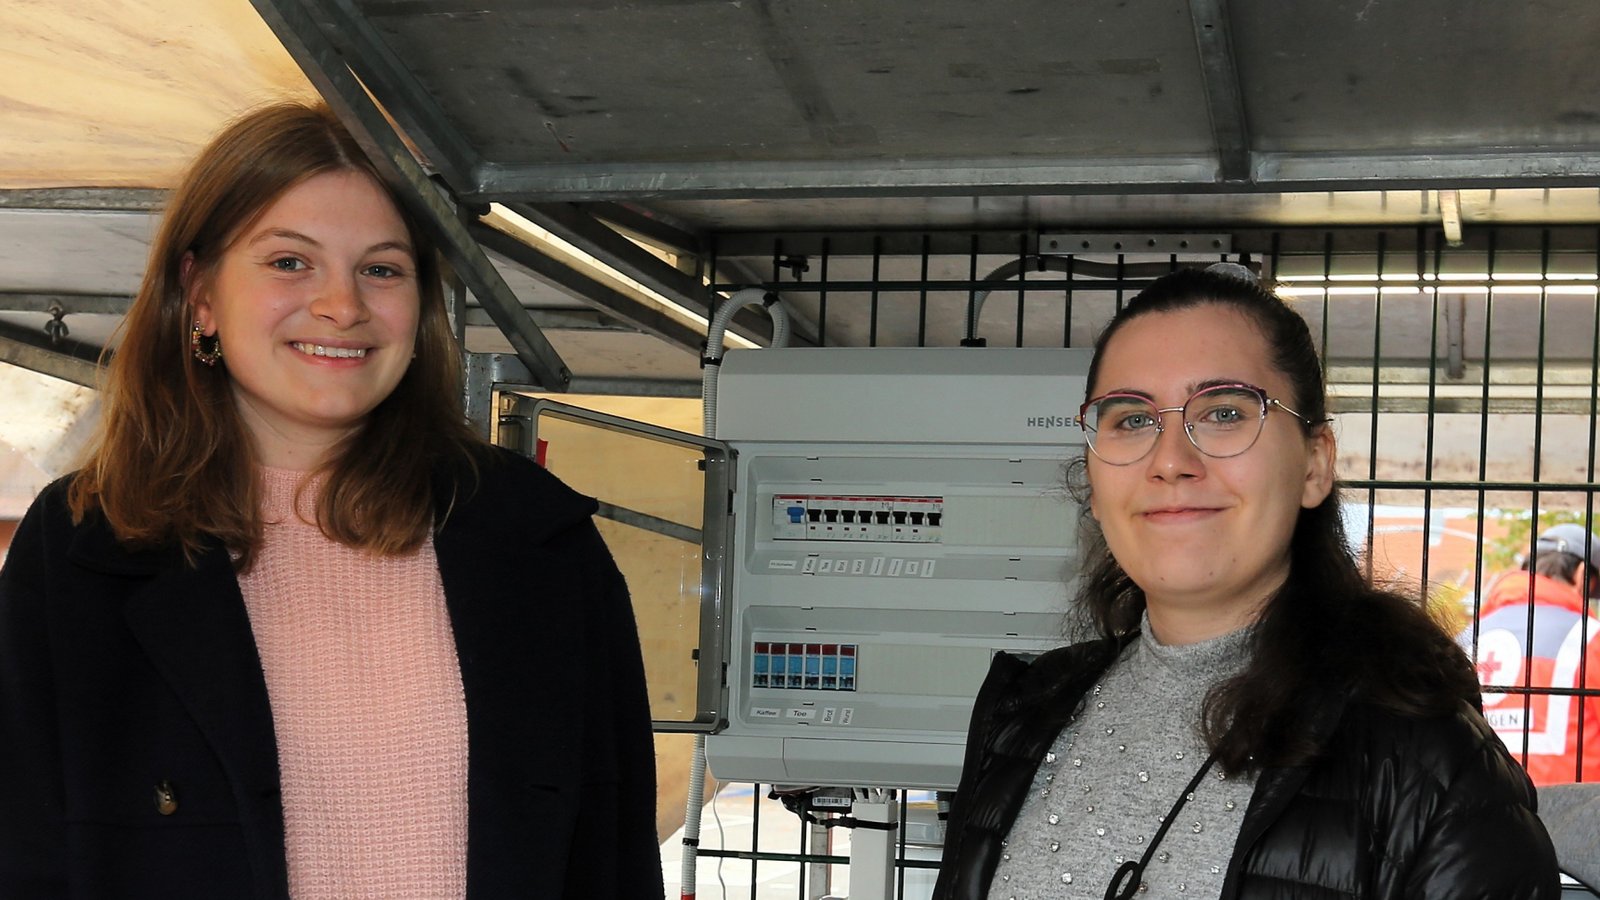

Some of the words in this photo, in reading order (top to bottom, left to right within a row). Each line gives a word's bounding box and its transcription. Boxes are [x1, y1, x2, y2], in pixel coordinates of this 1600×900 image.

[1027, 416, 1080, 428] HENSEL
[824, 709, 834, 722] Brot
[1485, 712, 1518, 726] GEN
